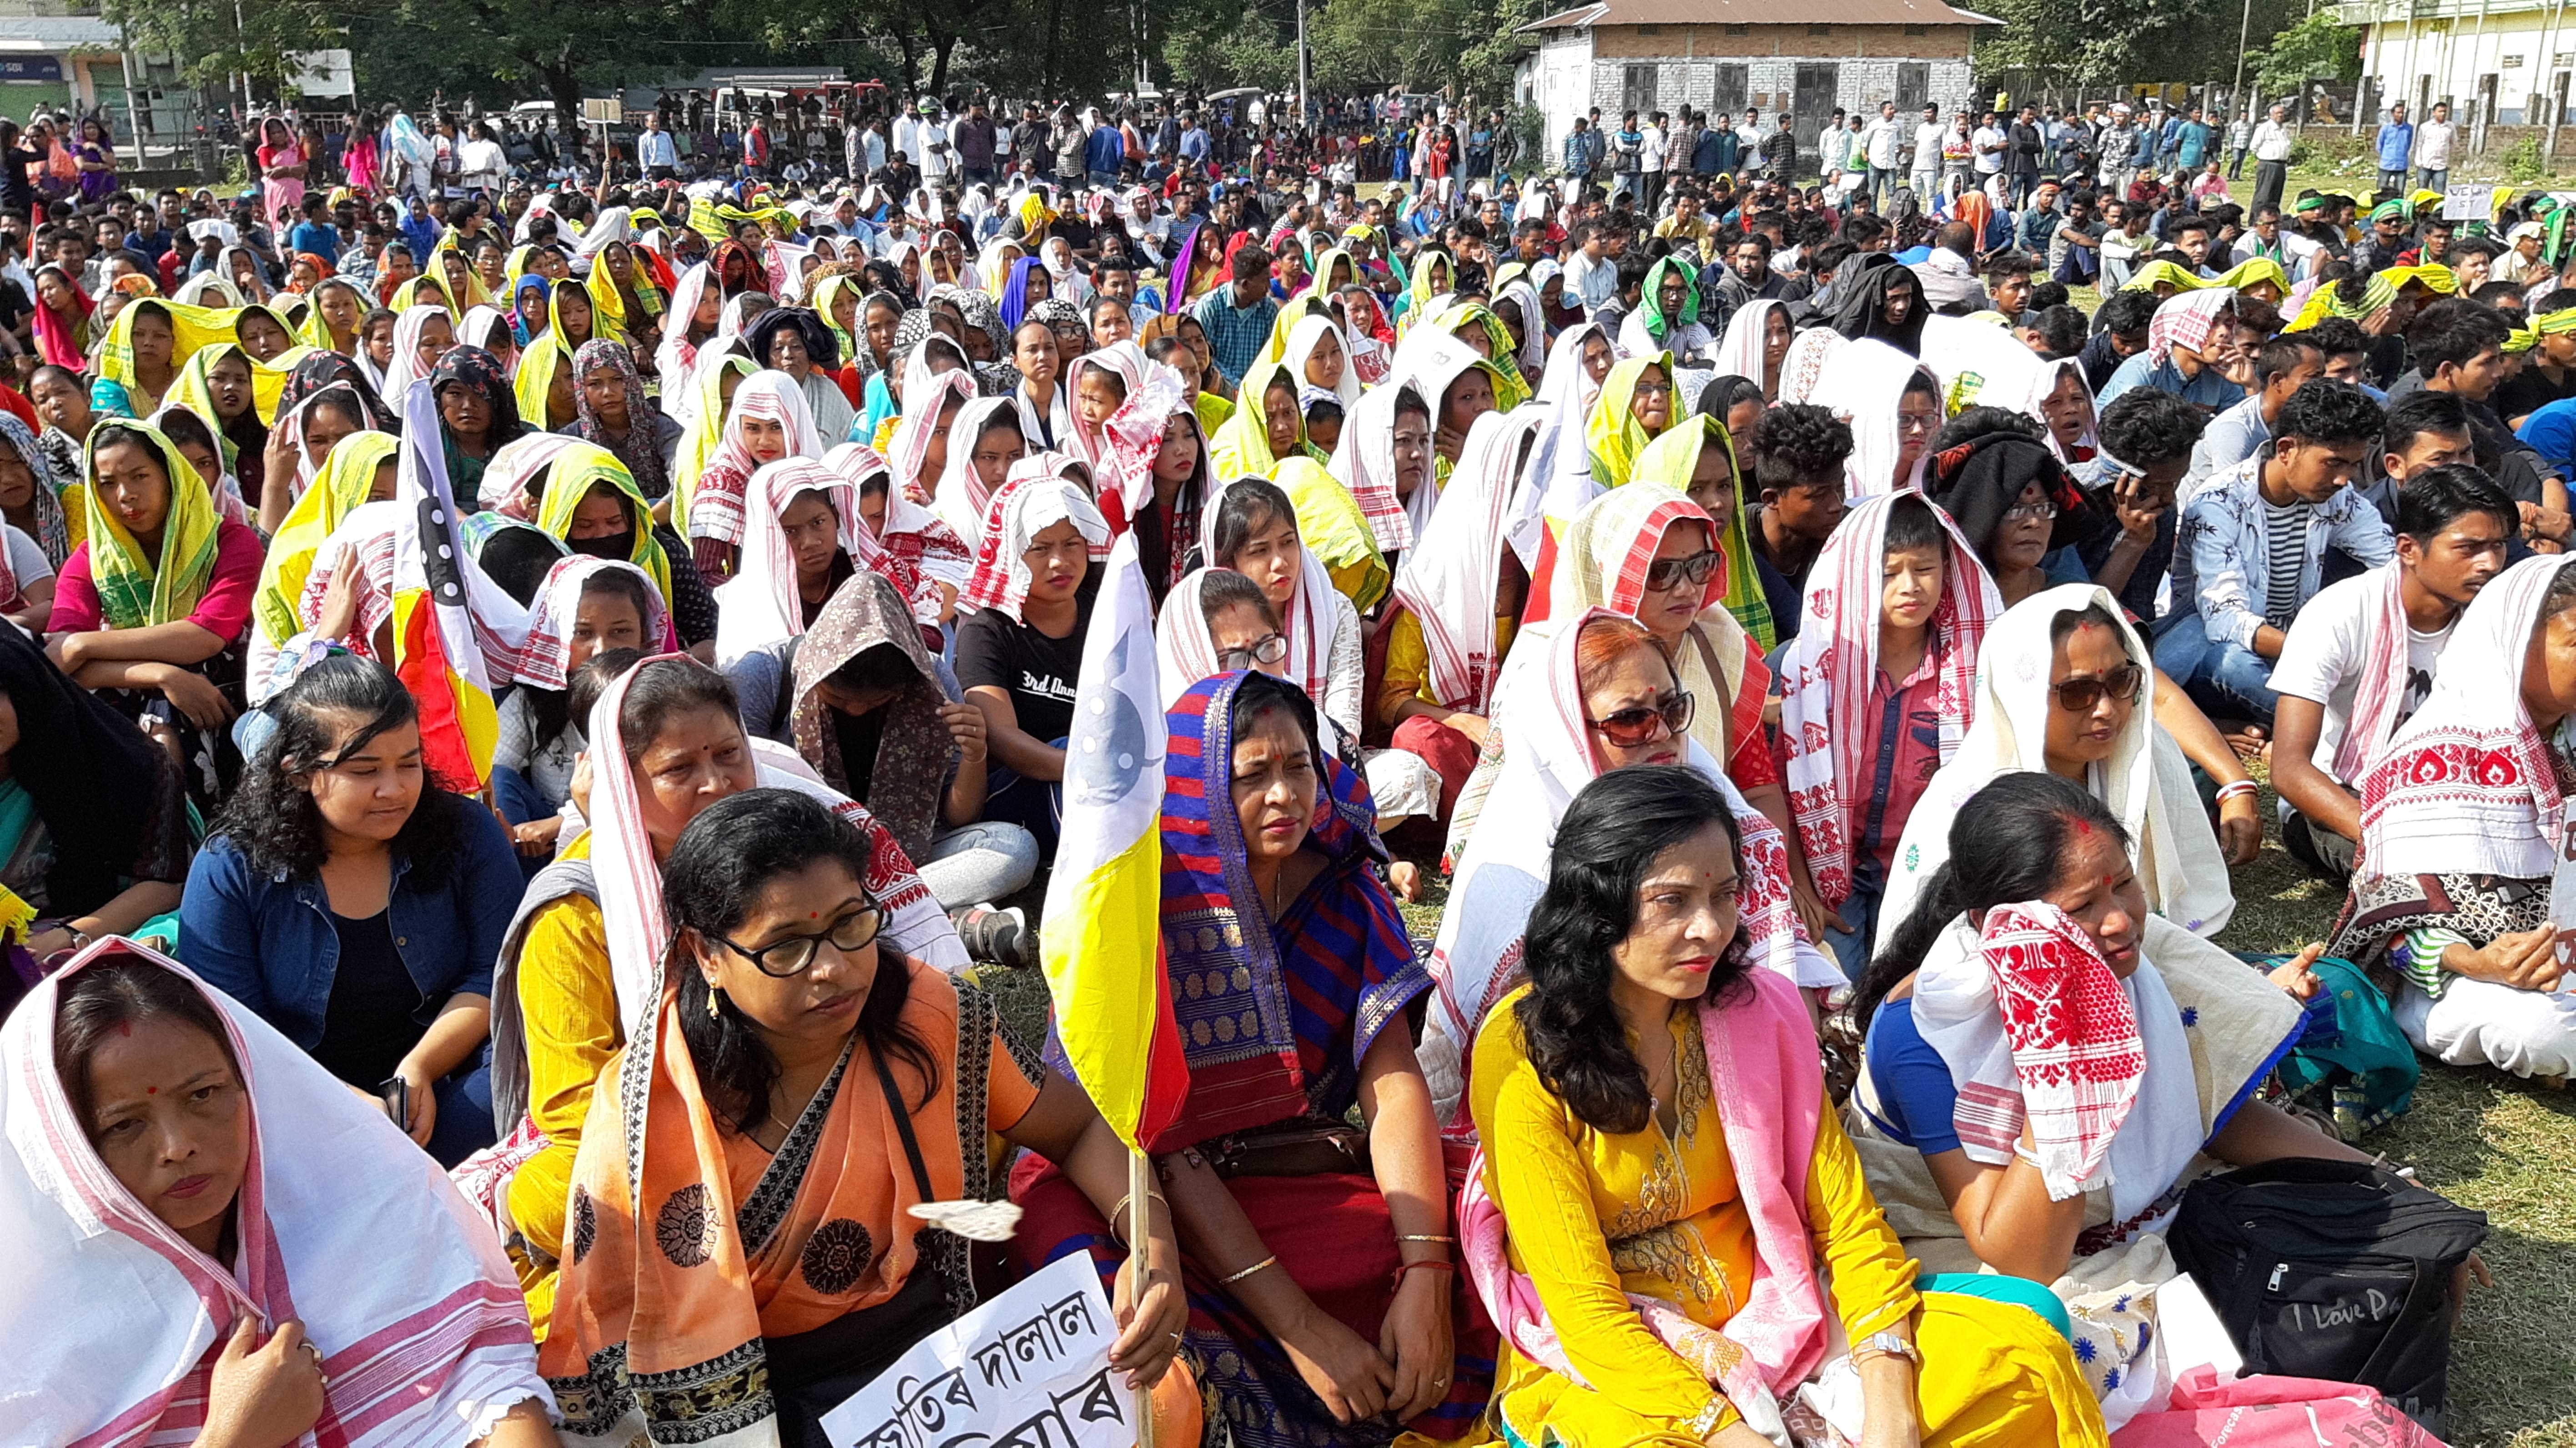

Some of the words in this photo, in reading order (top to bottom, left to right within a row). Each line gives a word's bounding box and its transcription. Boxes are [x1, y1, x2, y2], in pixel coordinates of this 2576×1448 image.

[2449, 186, 2469, 196] WE
[1022, 670, 1050, 692] 3rd
[1050, 677, 1077, 697] Ann
[971, 1290, 1098, 1389] দালাল
[2210, 1406, 2246, 1448] Forecas
